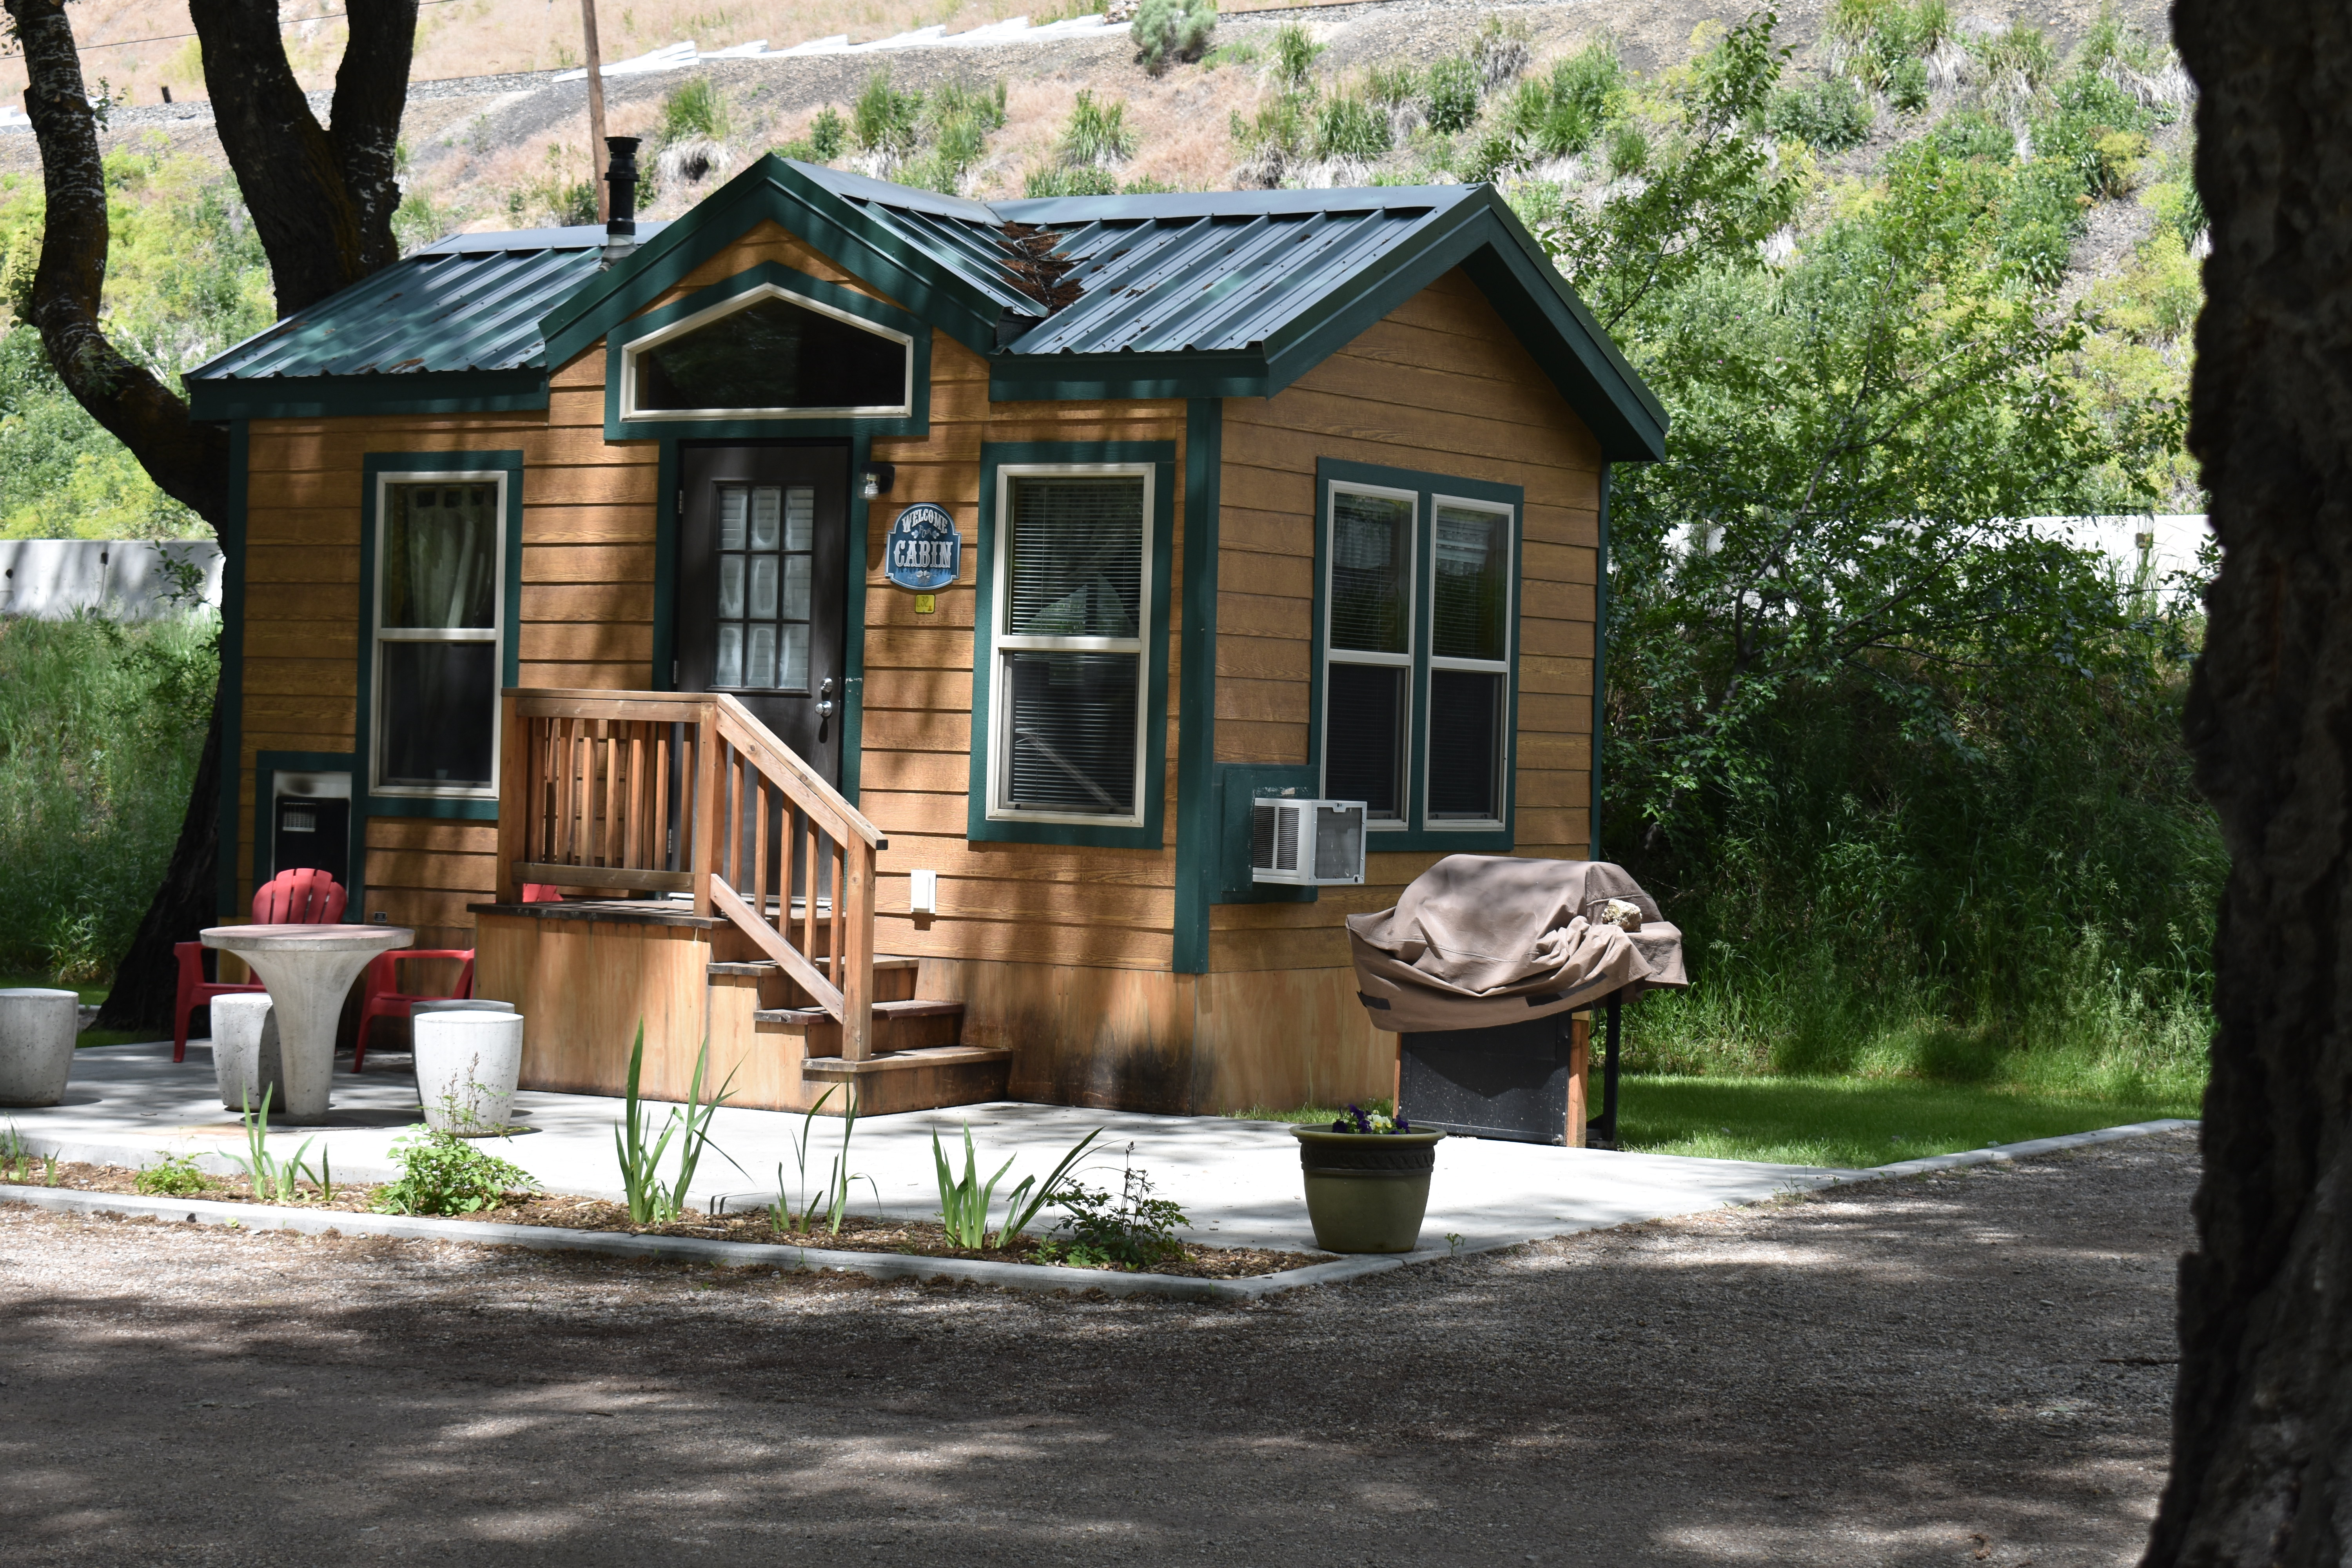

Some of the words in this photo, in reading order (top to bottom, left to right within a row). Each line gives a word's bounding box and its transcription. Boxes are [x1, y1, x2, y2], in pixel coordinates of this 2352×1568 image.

[902, 509, 948, 534] WELCOME
[894, 540, 953, 568] CABIN
[917, 596, 928, 607] L32
